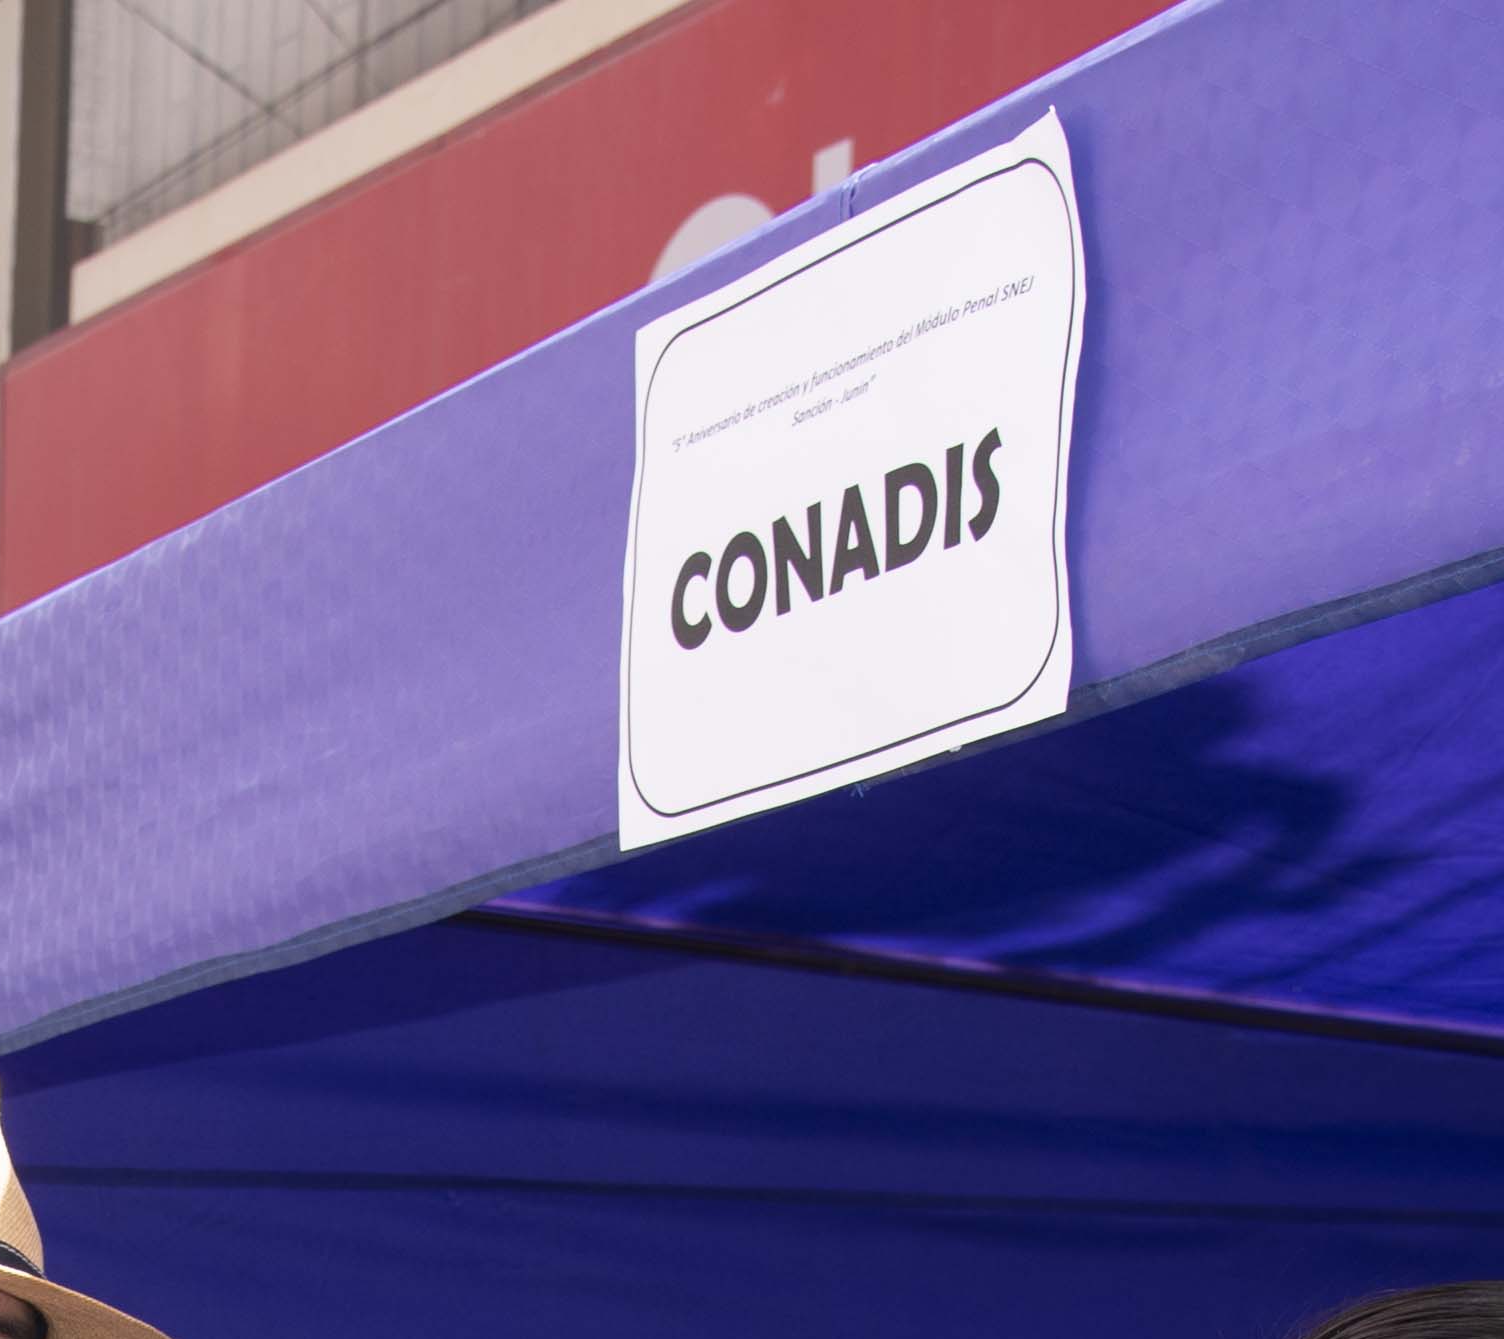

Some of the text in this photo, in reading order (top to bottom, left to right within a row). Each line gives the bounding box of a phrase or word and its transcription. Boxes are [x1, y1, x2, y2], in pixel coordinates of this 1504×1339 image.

[687, 412, 741, 447] Aniversario
[743, 402, 756, 420] de
[757, 383, 800, 414] creación
[801, 379, 809, 396] y
[809, 338, 894, 393] funcionamiento
[895, 324, 914, 348] del
[915, 306, 960, 337] Módulo
[961, 287, 1000, 318] Penal
[1001, 275, 1035, 301] SNEJ
[792, 398, 833, 427] Sanción
[671, 427, 1002, 650] CONADIS
